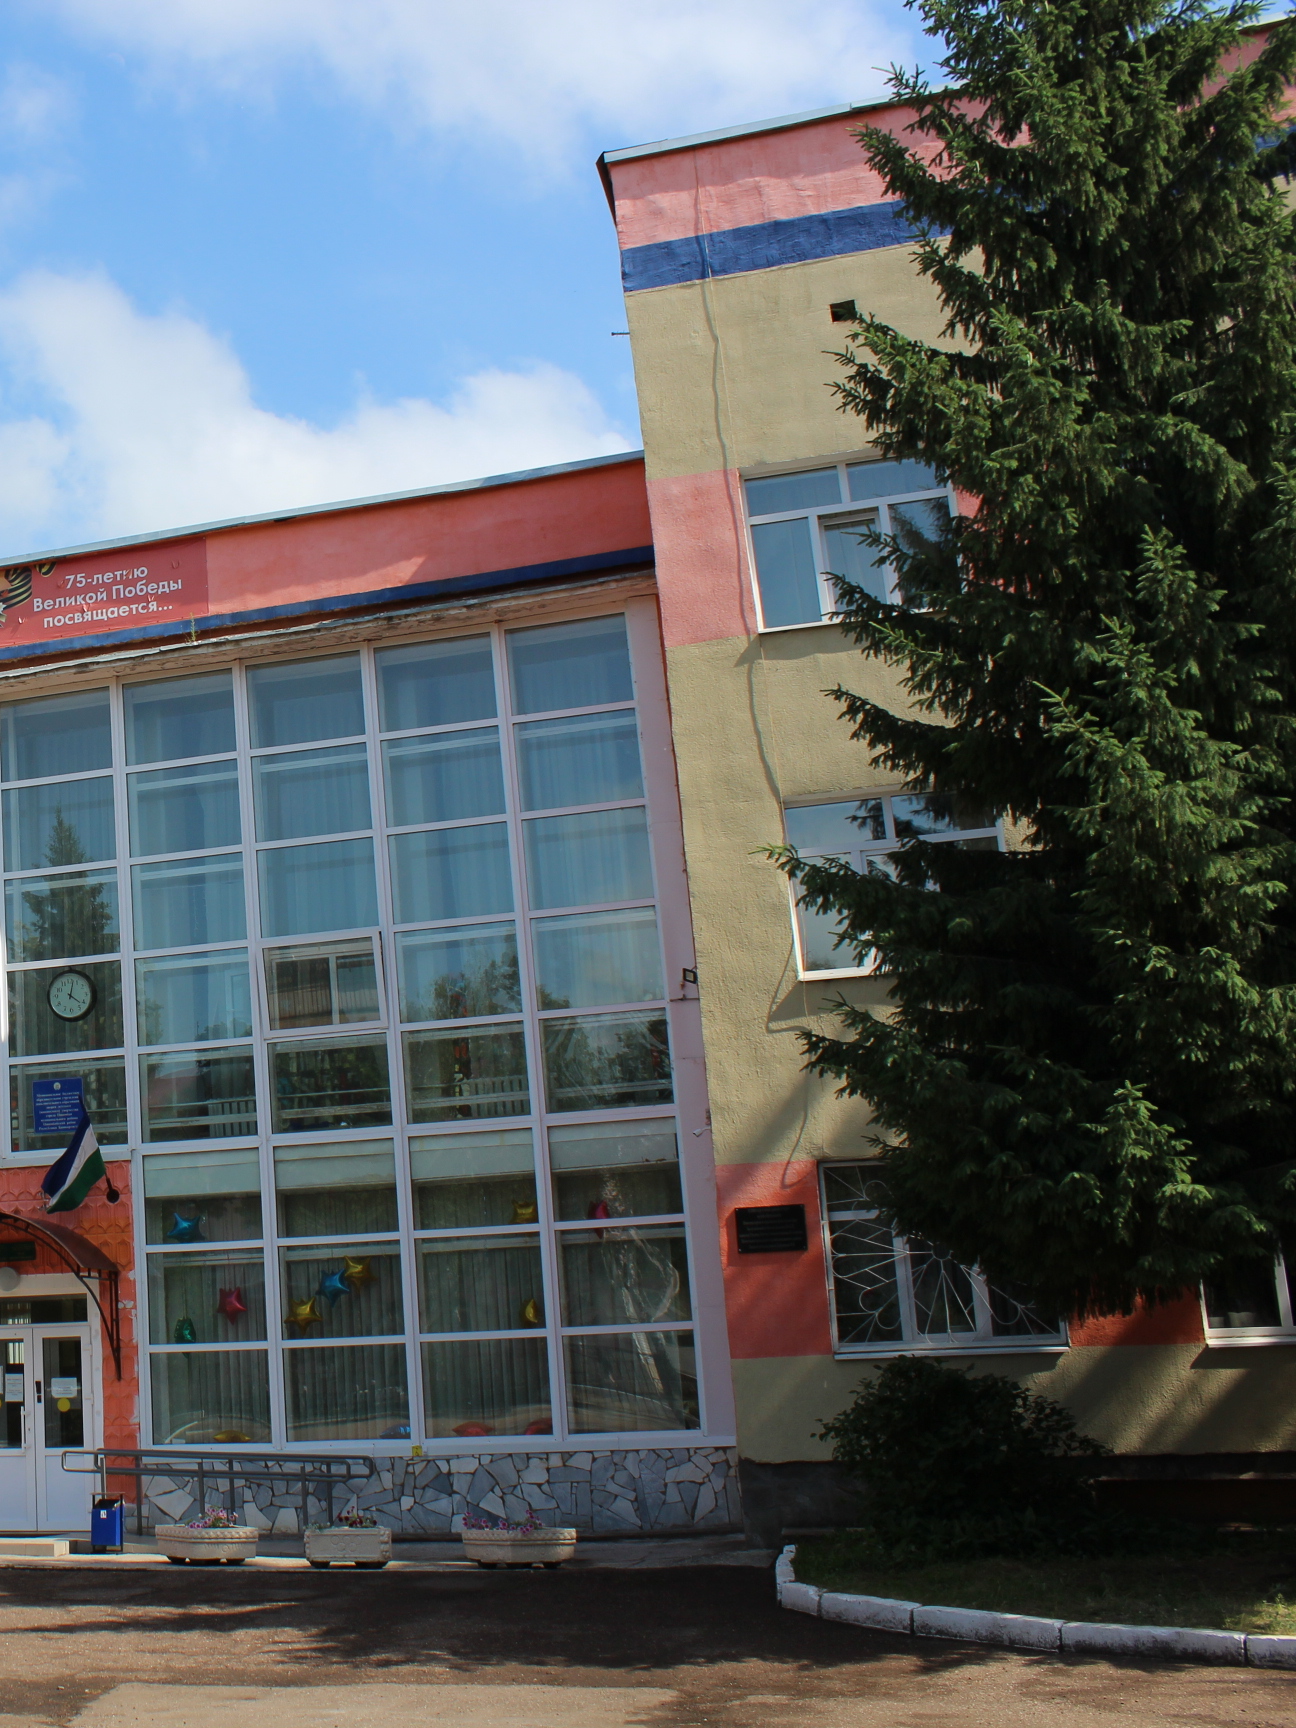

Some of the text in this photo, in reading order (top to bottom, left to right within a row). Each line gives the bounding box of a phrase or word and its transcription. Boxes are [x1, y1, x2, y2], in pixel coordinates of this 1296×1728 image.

[65, 566, 149, 589] 75-летию
[33, 578, 183, 612] Великой Победы
[43, 601, 173, 628] посвящается...
